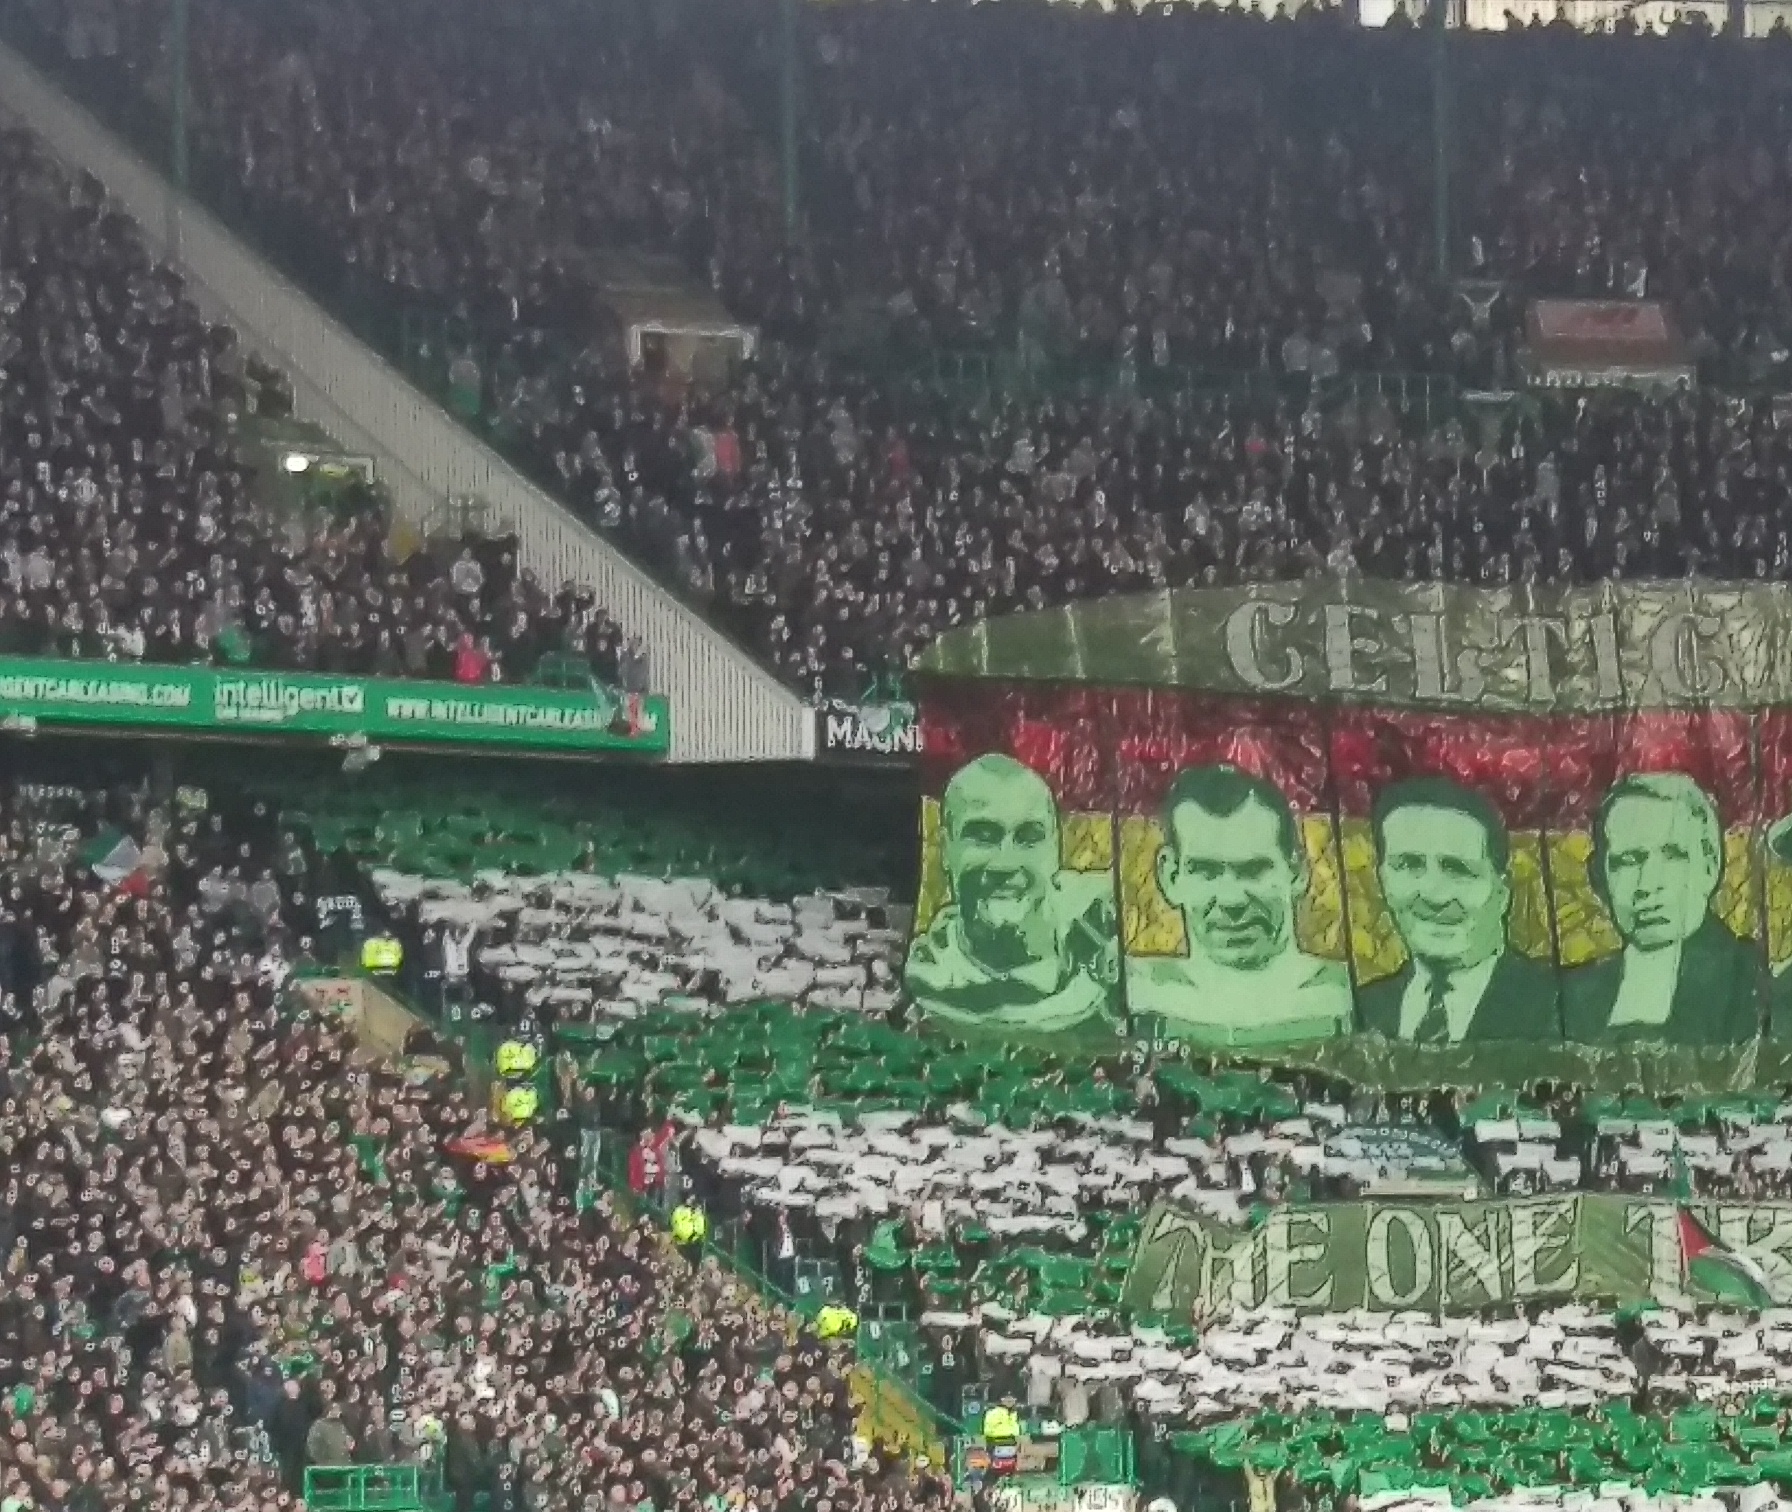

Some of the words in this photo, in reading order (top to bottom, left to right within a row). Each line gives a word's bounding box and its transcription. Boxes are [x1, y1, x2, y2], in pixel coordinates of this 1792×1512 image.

[1226, 600, 1726, 712] CELTIC
[1150, 1208, 1332, 1313] THE
[1366, 1197, 1581, 1303] ONE
